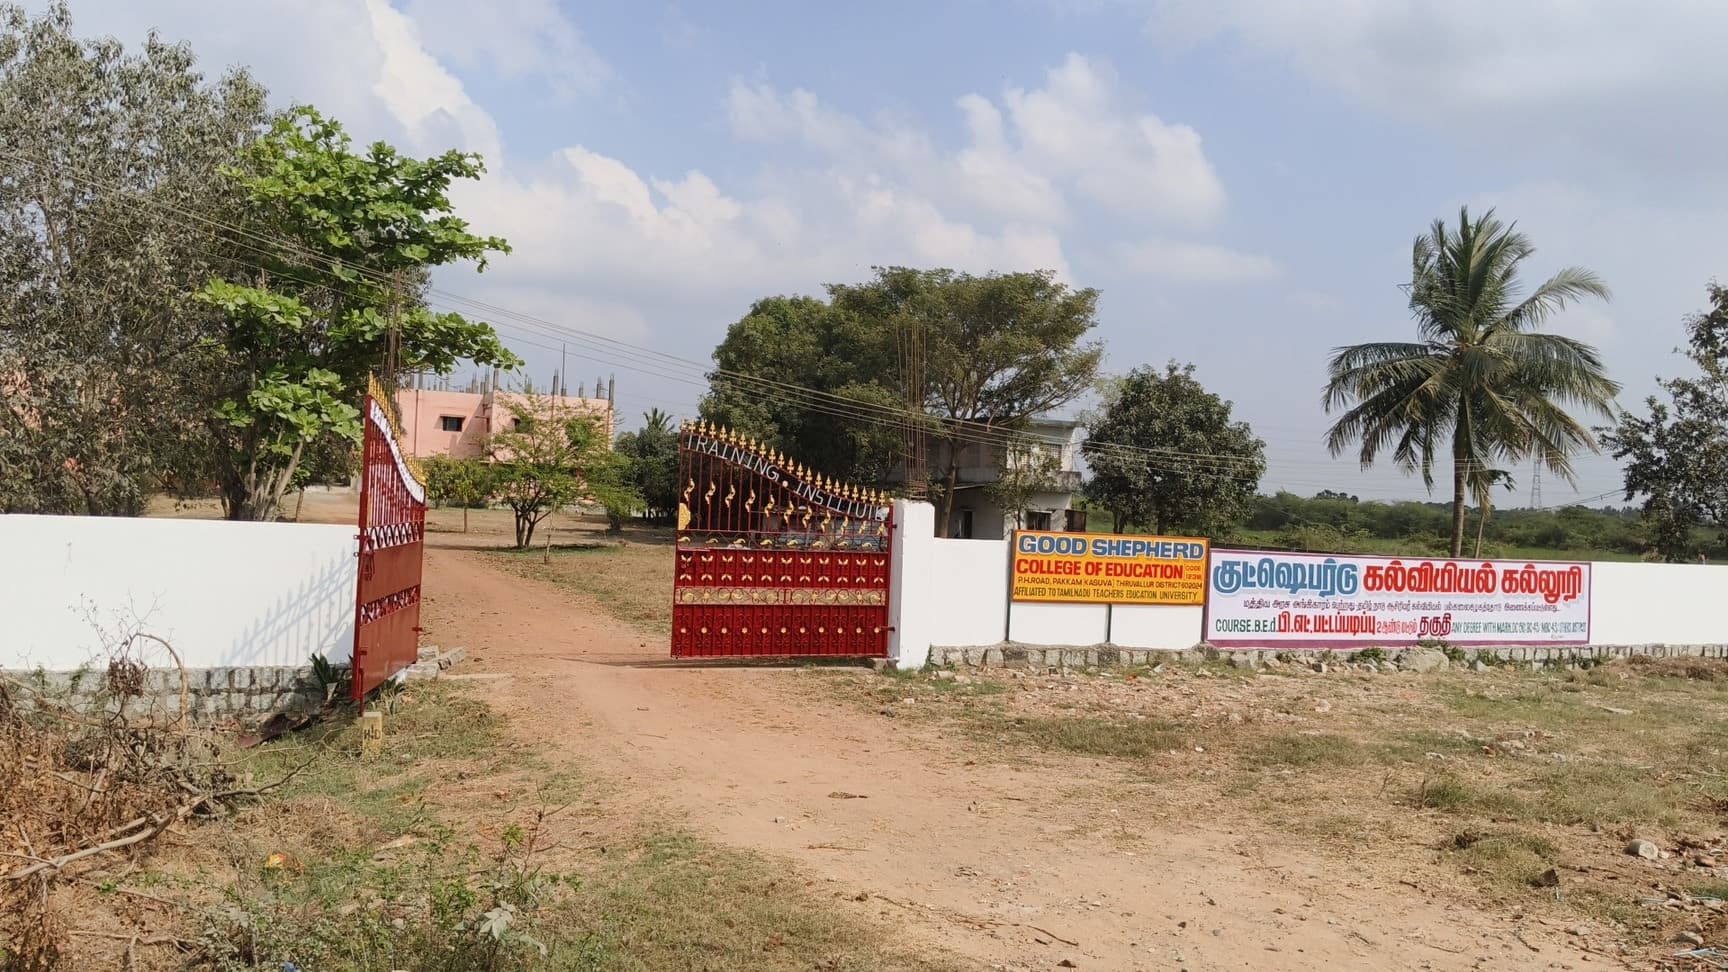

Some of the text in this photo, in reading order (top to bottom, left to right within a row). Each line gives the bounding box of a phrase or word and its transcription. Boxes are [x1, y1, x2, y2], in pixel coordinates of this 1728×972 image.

[1019, 535, 1204, 559] GOOD SHEPHERD
[1016, 558, 1183, 579] COLLEGE OF EDUCATION
[1053, 577, 1082, 586] PAKKAM
[1117, 580, 1154, 588] THIRUVALLUR
[1364, 560, 1496, 594] கல்வியியல்
[1502, 563, 1582, 603] கல்லூரி
[1015, 586, 1198, 601] AFFILIATED TO TAMILNADU TEACHERS EDUCATION UNIVERSITY
[1418, 612, 1451, 638] தகுதி
[1452, 621, 1462, 633] ANY
[1464, 621, 1481, 633] DEGREE
[1483, 621, 1496, 633] WITH
